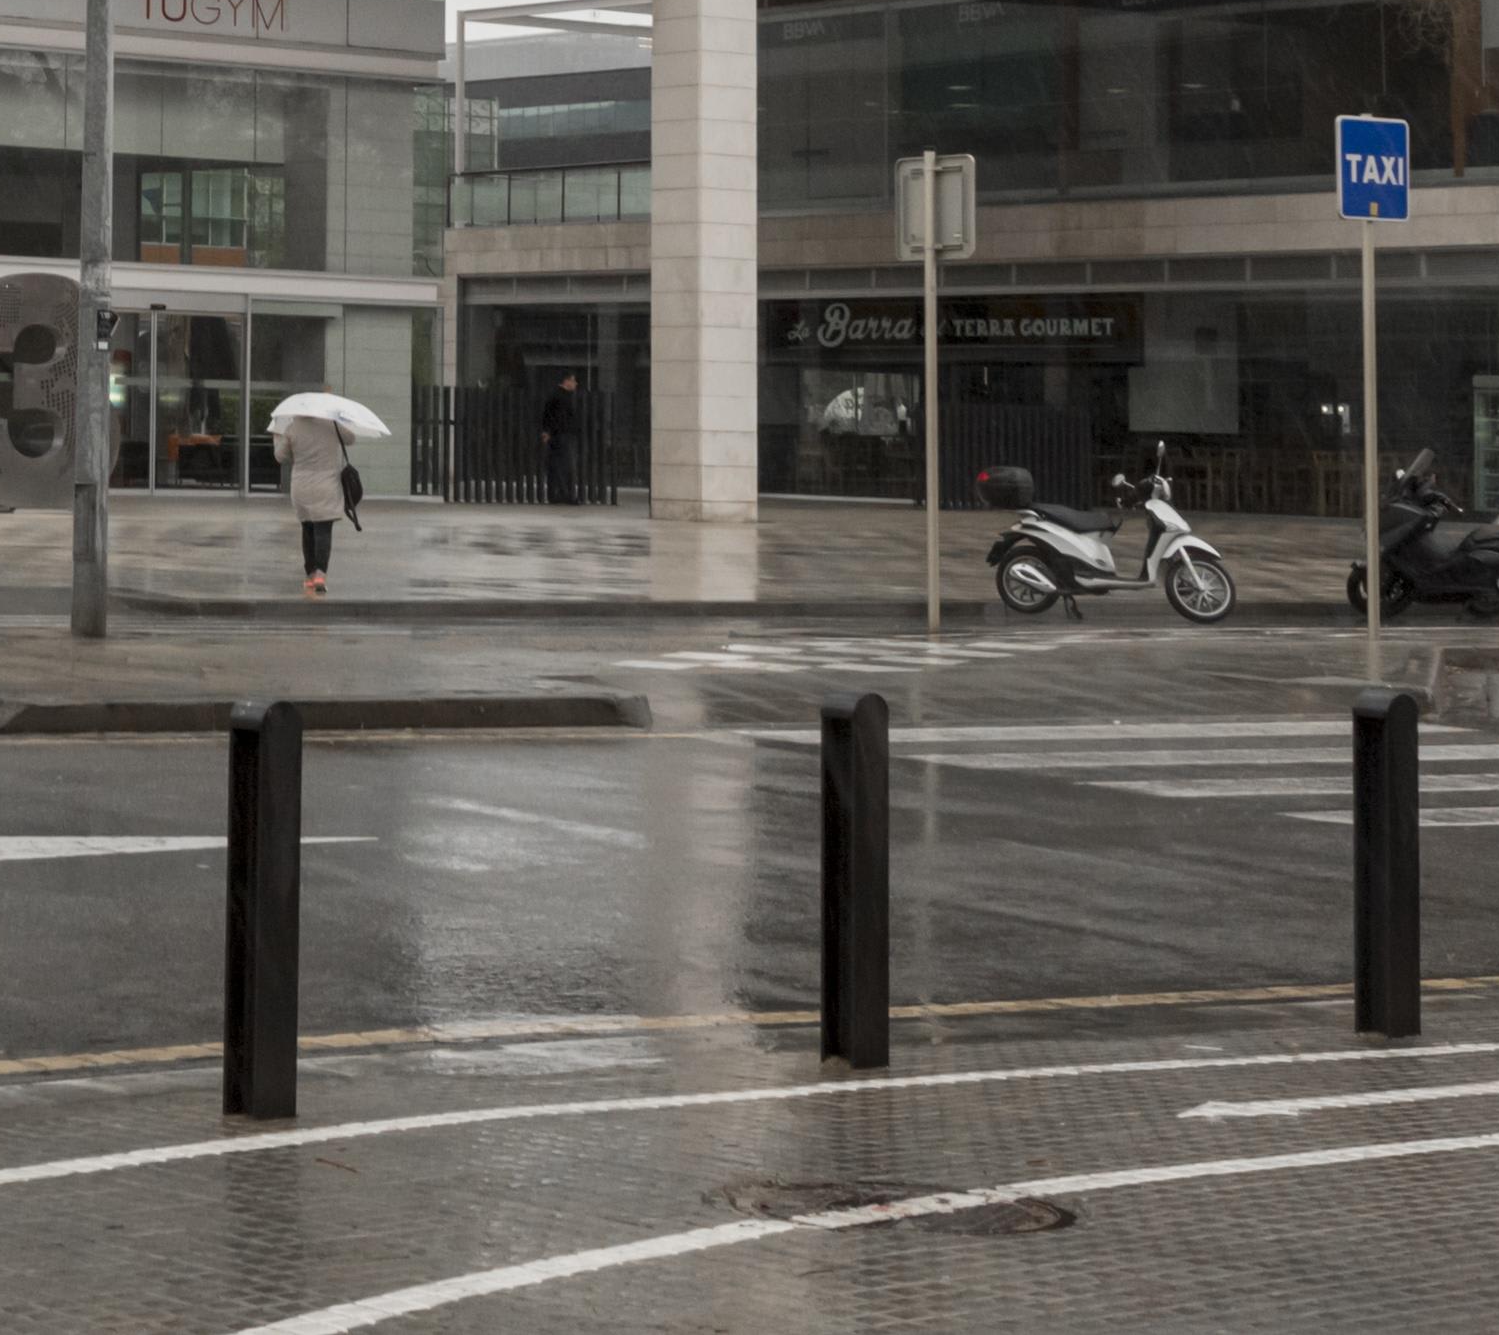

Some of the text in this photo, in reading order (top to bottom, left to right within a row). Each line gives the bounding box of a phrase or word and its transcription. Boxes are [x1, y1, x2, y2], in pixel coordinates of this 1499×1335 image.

[959, 2, 1005, 22] BBVA
[783, 20, 825, 40] BBVA
[1345, 154, 1404, 186] TAXI
[817, 303, 916, 348] Barra
[953, 318, 1016, 338] TERRA
[1019, 317, 1115, 338] GOURMET
